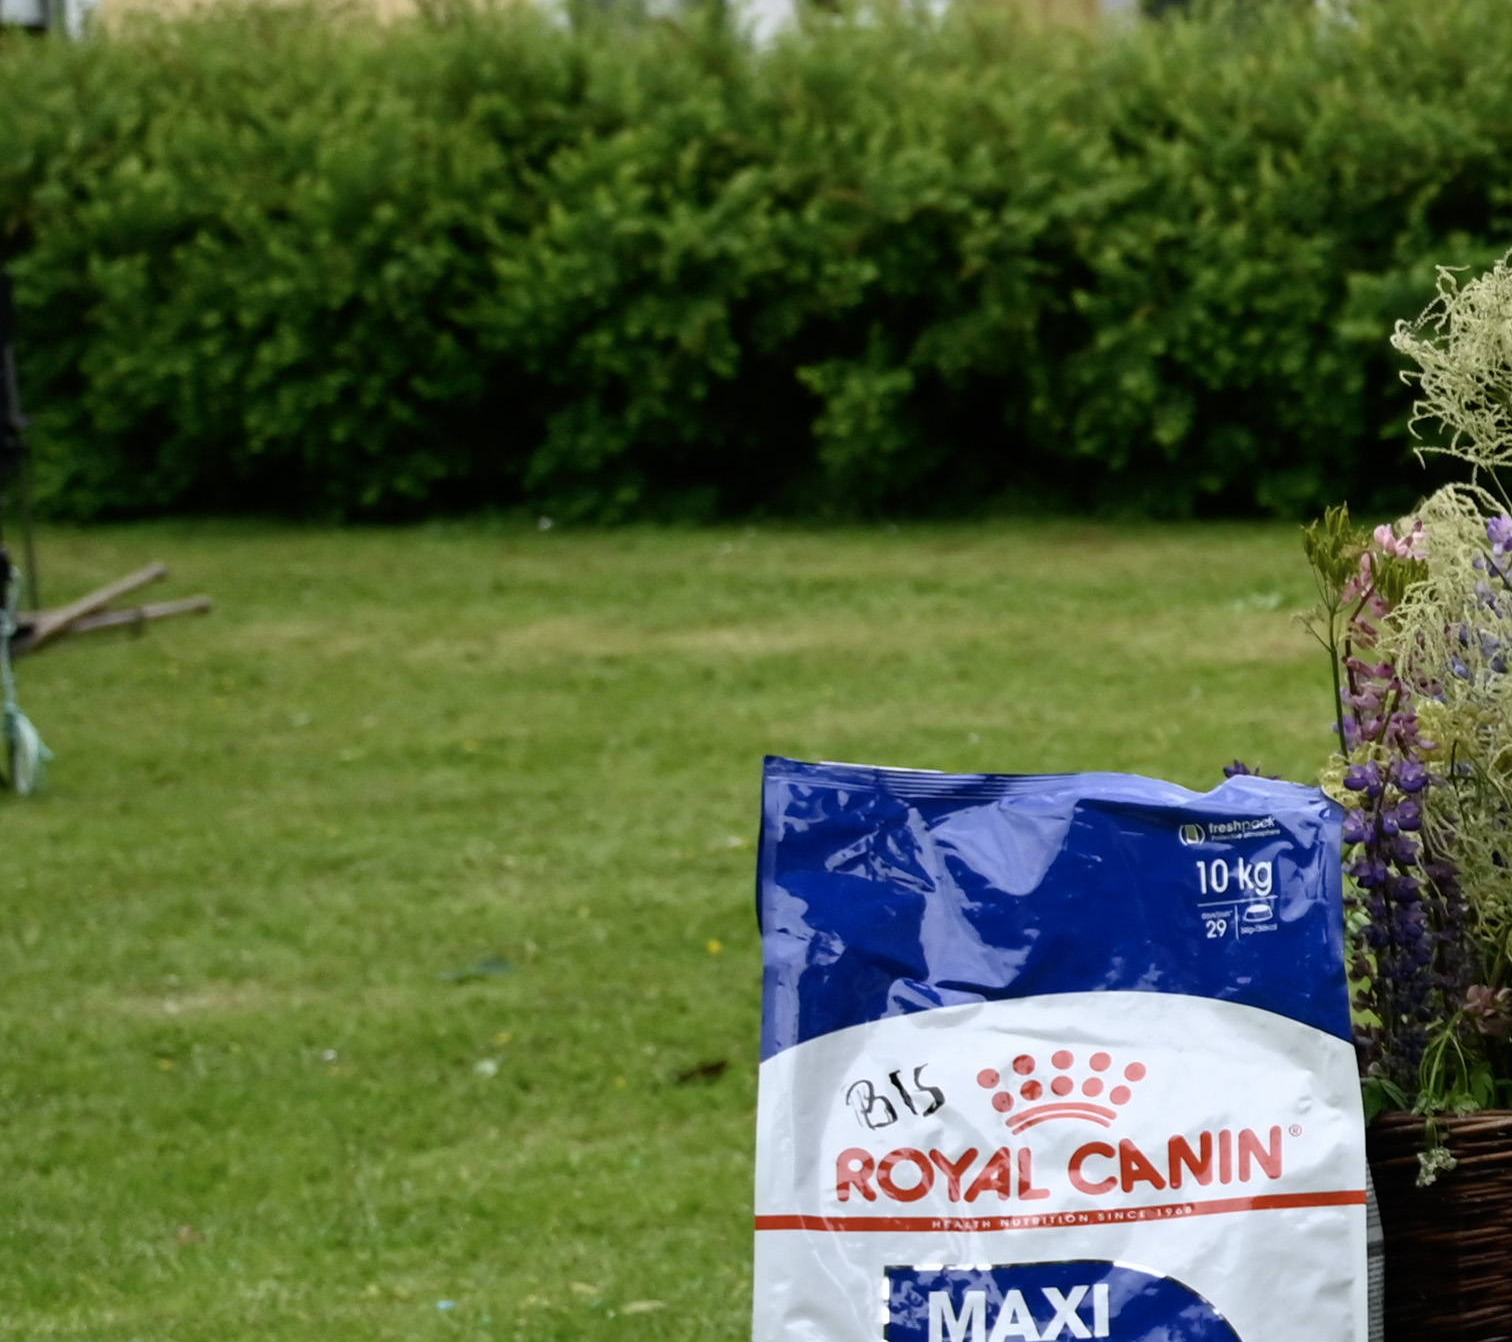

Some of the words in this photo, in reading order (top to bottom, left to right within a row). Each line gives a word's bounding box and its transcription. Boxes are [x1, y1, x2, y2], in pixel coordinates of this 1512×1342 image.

[1196, 858, 1229, 894] 10
[1238, 857, 1273, 896] kg
[1205, 919, 1227, 938] 29
[836, 1146, 1051, 1203] ROYAL
[932, 1219, 991, 1230] HEALTH
[1001, 1213, 1089, 1228] NUTRITION
[1098, 1209, 1147, 1221] SINCE
[1157, 1206, 1193, 1217] 1968
